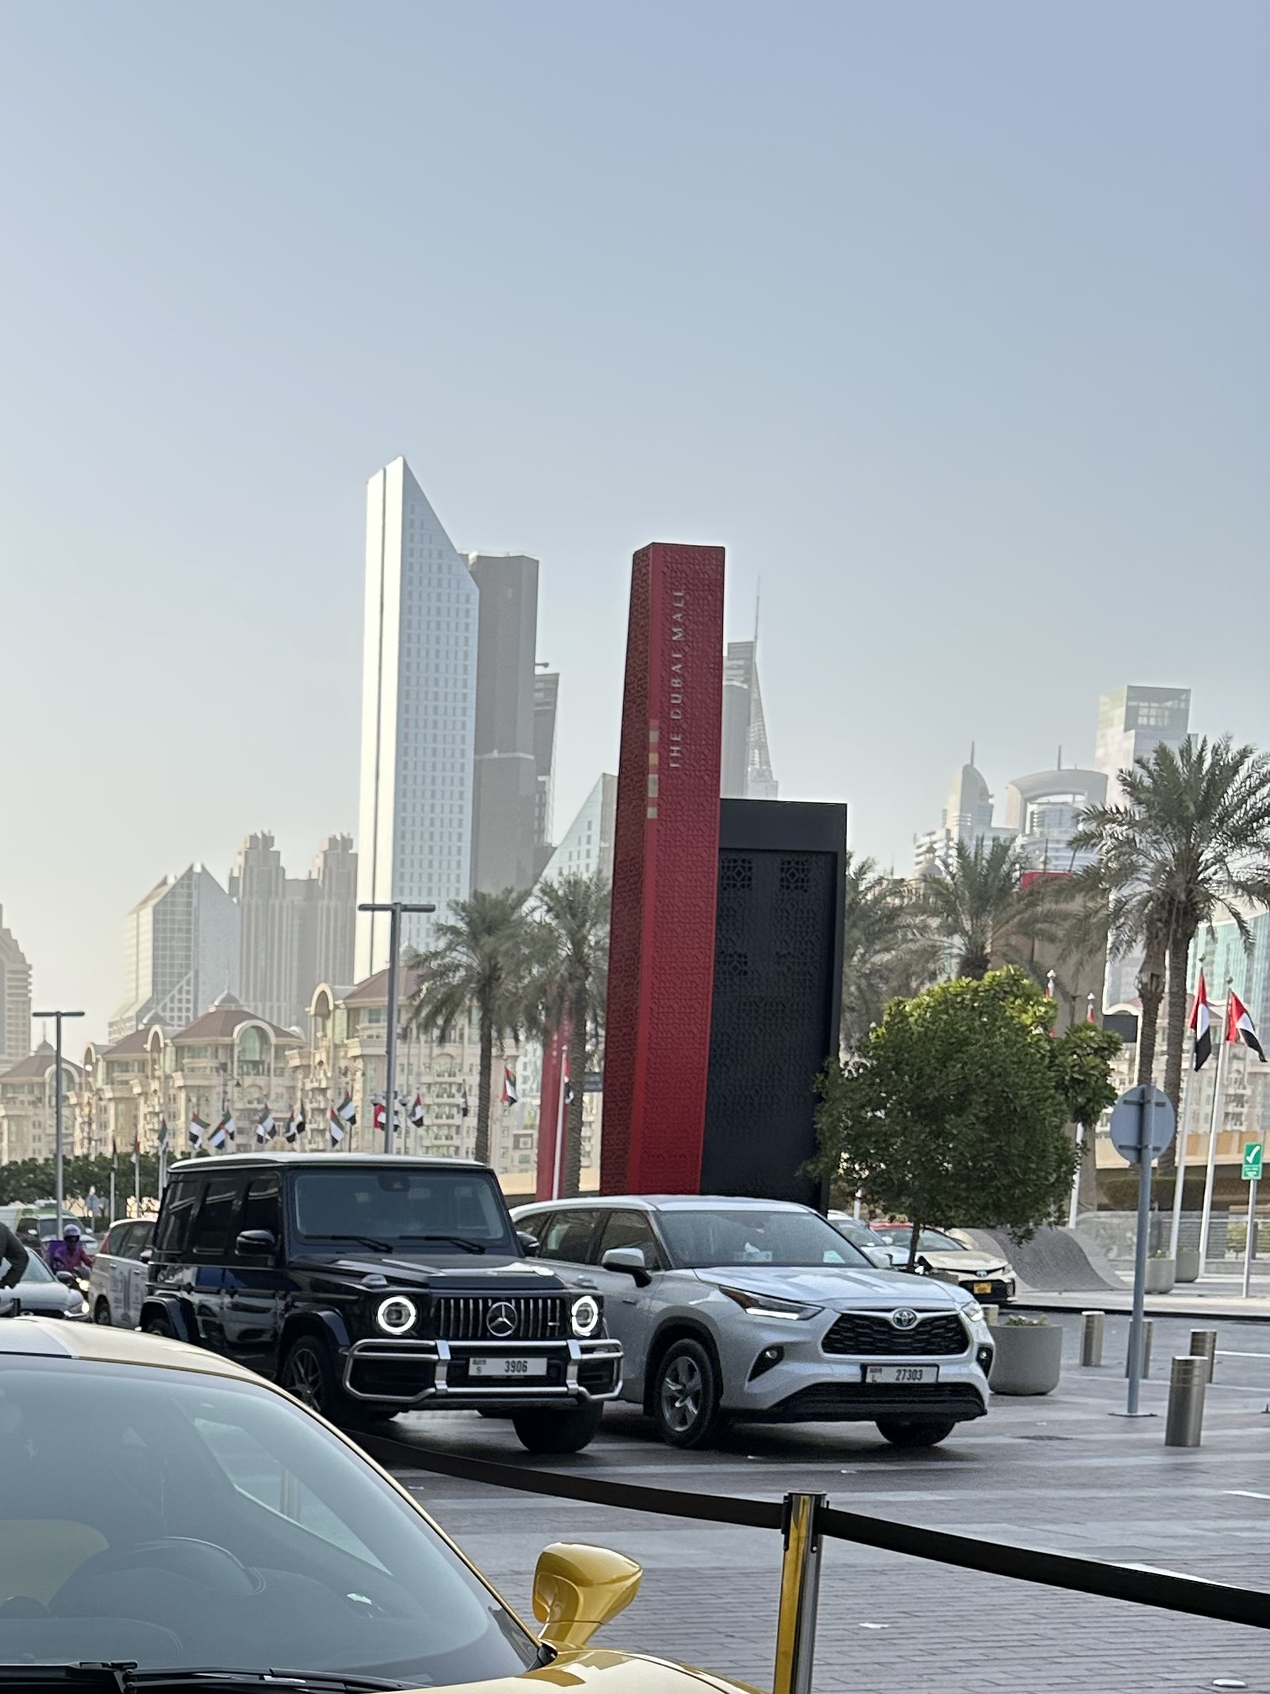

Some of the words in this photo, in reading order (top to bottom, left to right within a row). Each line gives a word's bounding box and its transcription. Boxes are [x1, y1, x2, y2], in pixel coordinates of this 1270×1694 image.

[671, 590, 685, 642] MALL
[669, 653, 684, 720] DUBAI
[669, 733, 684, 768] THE
[504, 1360, 529, 1373] 3906
[895, 1368, 924, 1382] 27303
